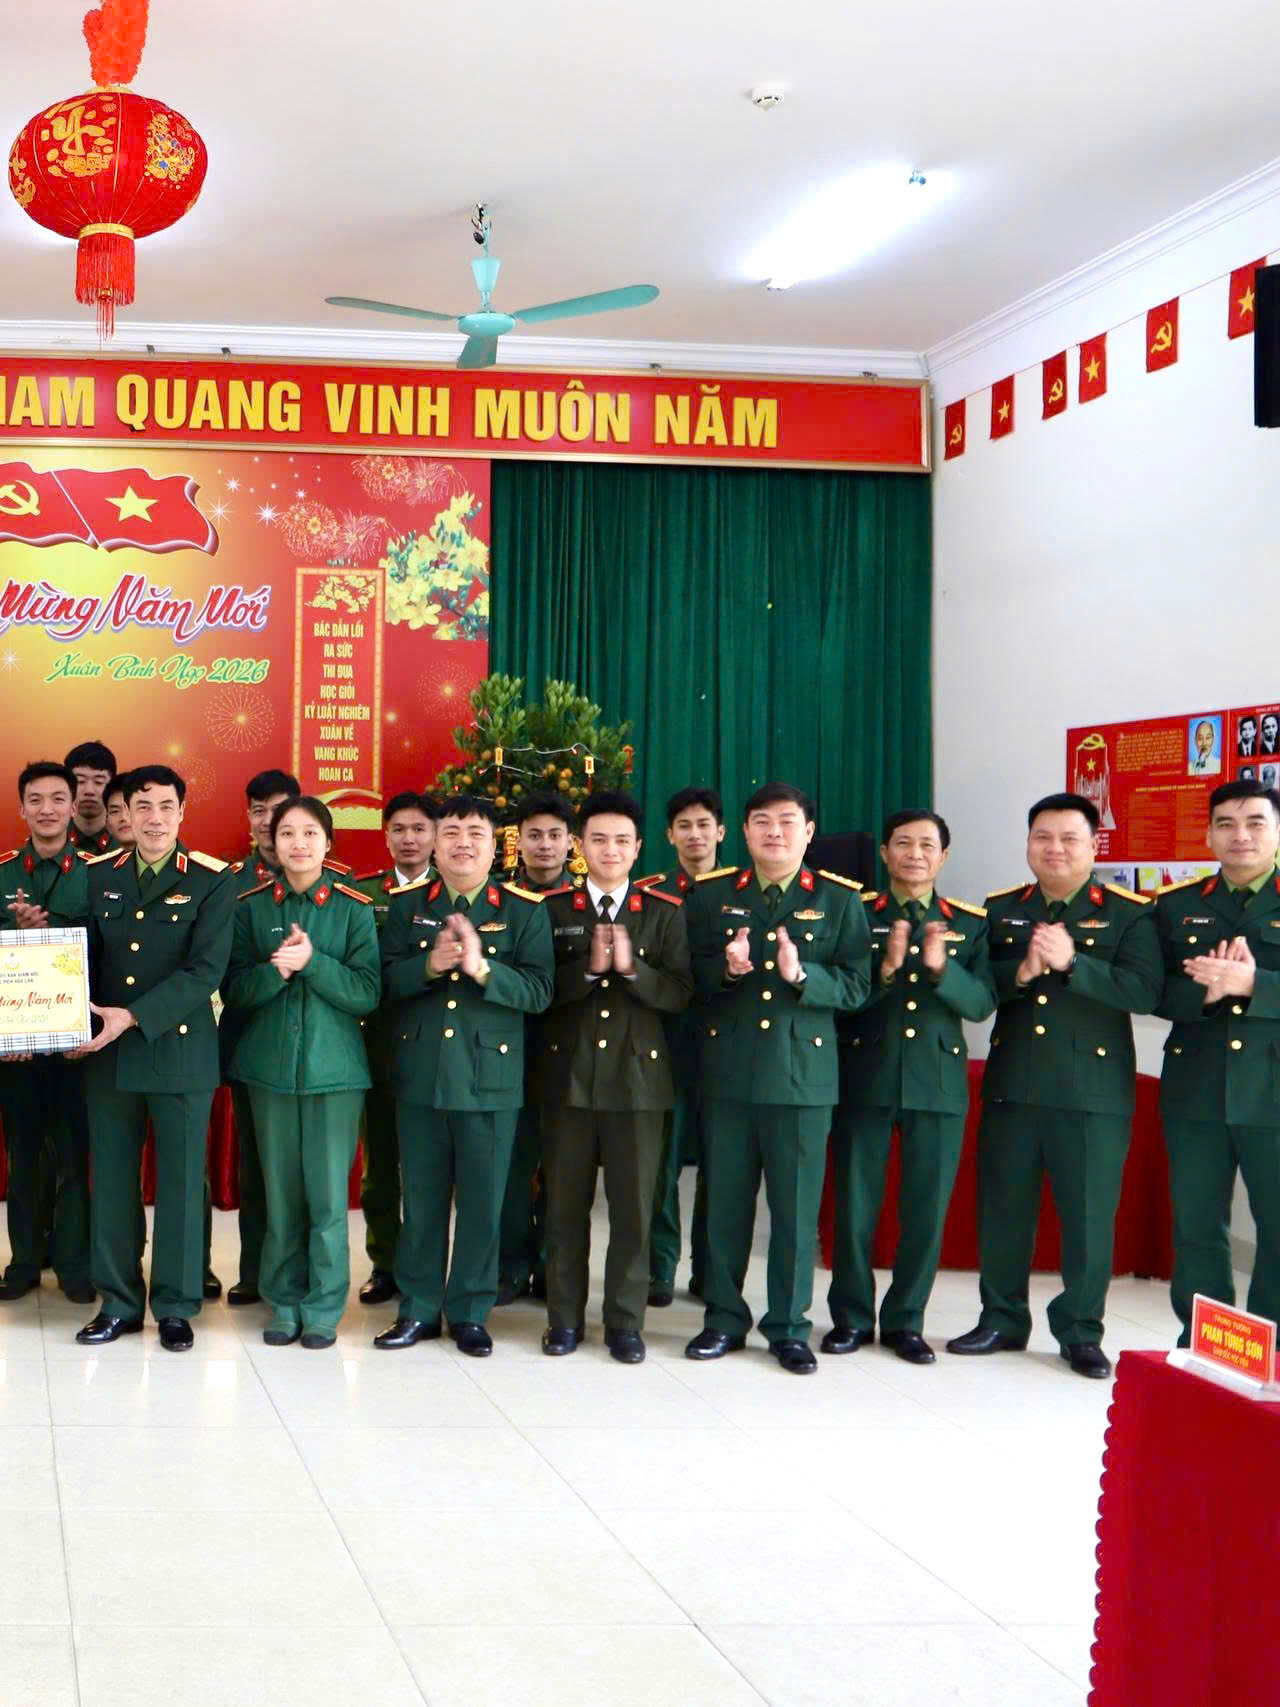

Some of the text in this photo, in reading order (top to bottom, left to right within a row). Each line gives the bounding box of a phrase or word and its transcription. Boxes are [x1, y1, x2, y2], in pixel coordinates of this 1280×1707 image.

[116, 374, 301, 432] QUANG
[325, 383, 449, 437] VINH
[475, 380, 631, 443] MUÔN
[655, 385, 778, 448] NĂM
[94, 573, 194, 642] Năm
[194, 584, 272, 631] Mới
[314, 620, 331, 637] BÁC
[351, 618, 364, 638] LỐI
[323, 640, 354, 658] RA SỨC
[43, 652, 102, 683] Xuân
[159, 653, 208, 689] Ngọ
[207, 657, 270, 683] 2026
[323, 663, 354, 678] THI ĐUA
[339, 681, 356, 699] GIỎI
[317, 702, 337, 722] LUẬT
[338, 704, 370, 720] NGHIÊM
[320, 724, 343, 740] XUÂN
[314, 744, 359, 761] VANG KHÚC
[318, 767, 354, 782] HOAN CA
[1201, 1322, 1223, 1345] PHAN
